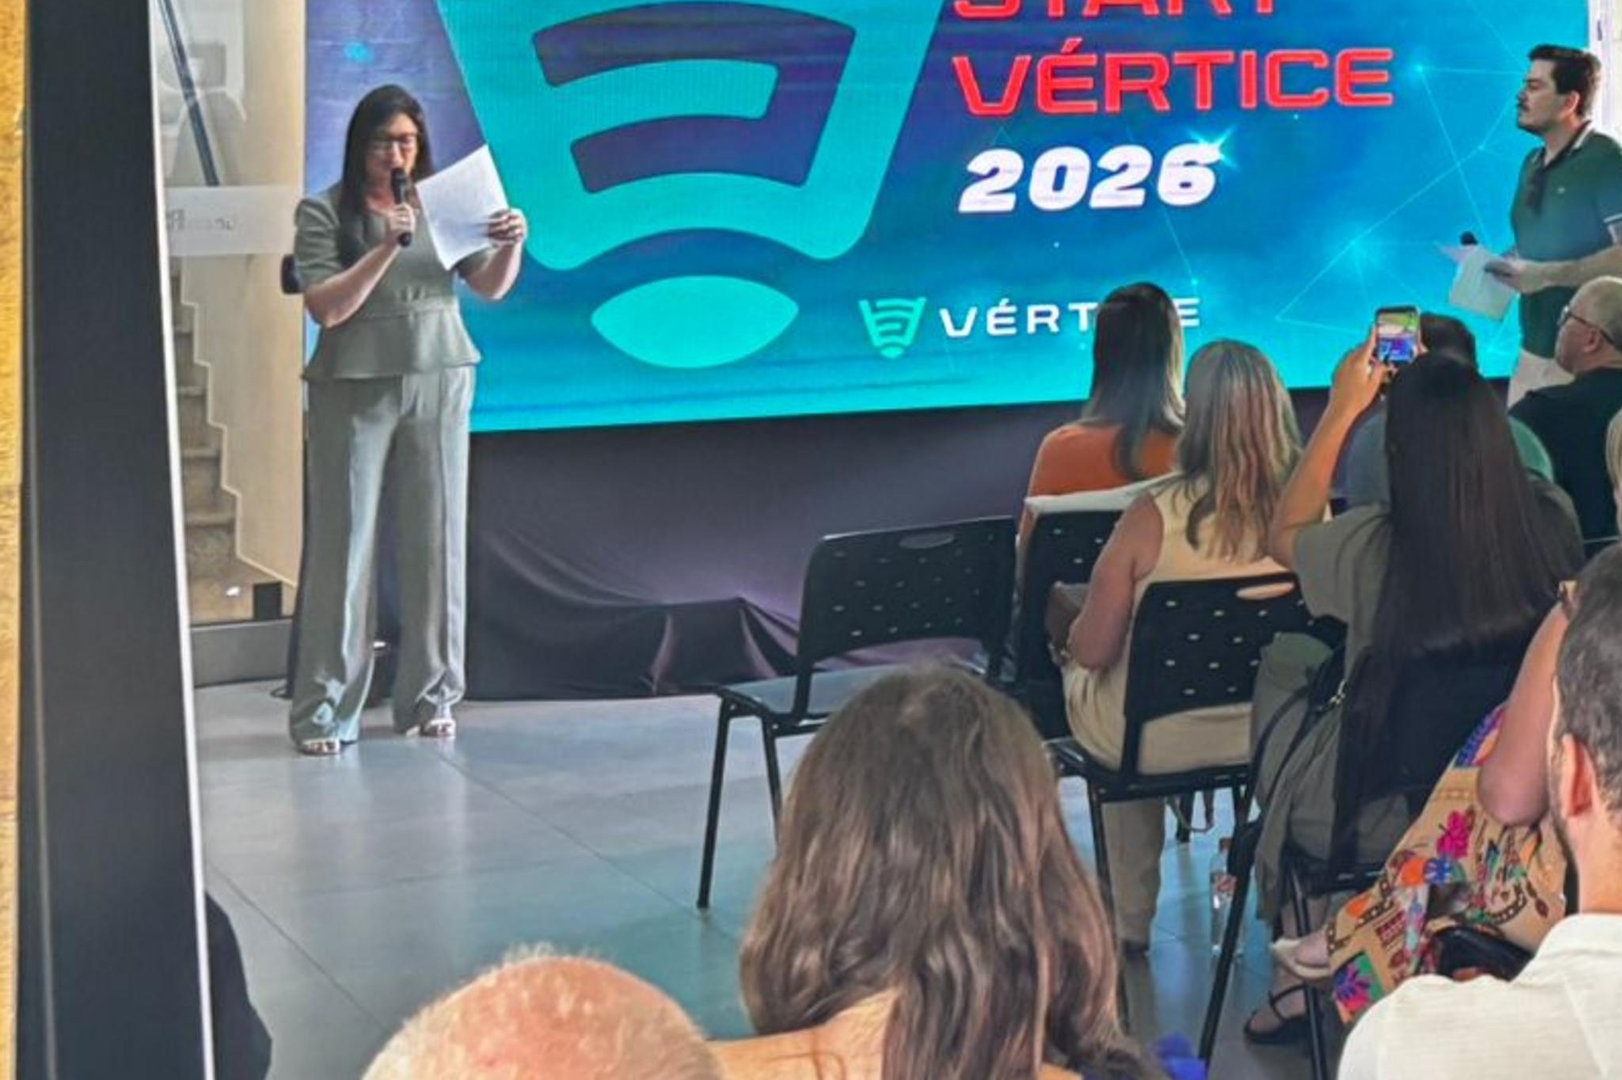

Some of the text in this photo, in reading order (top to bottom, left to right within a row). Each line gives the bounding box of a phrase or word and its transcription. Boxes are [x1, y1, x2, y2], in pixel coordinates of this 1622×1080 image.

[951, 37, 1395, 116] VÉRTICE
[957, 142, 1220, 214] 2026
[938, 297, 1201, 338] VÉRTE
